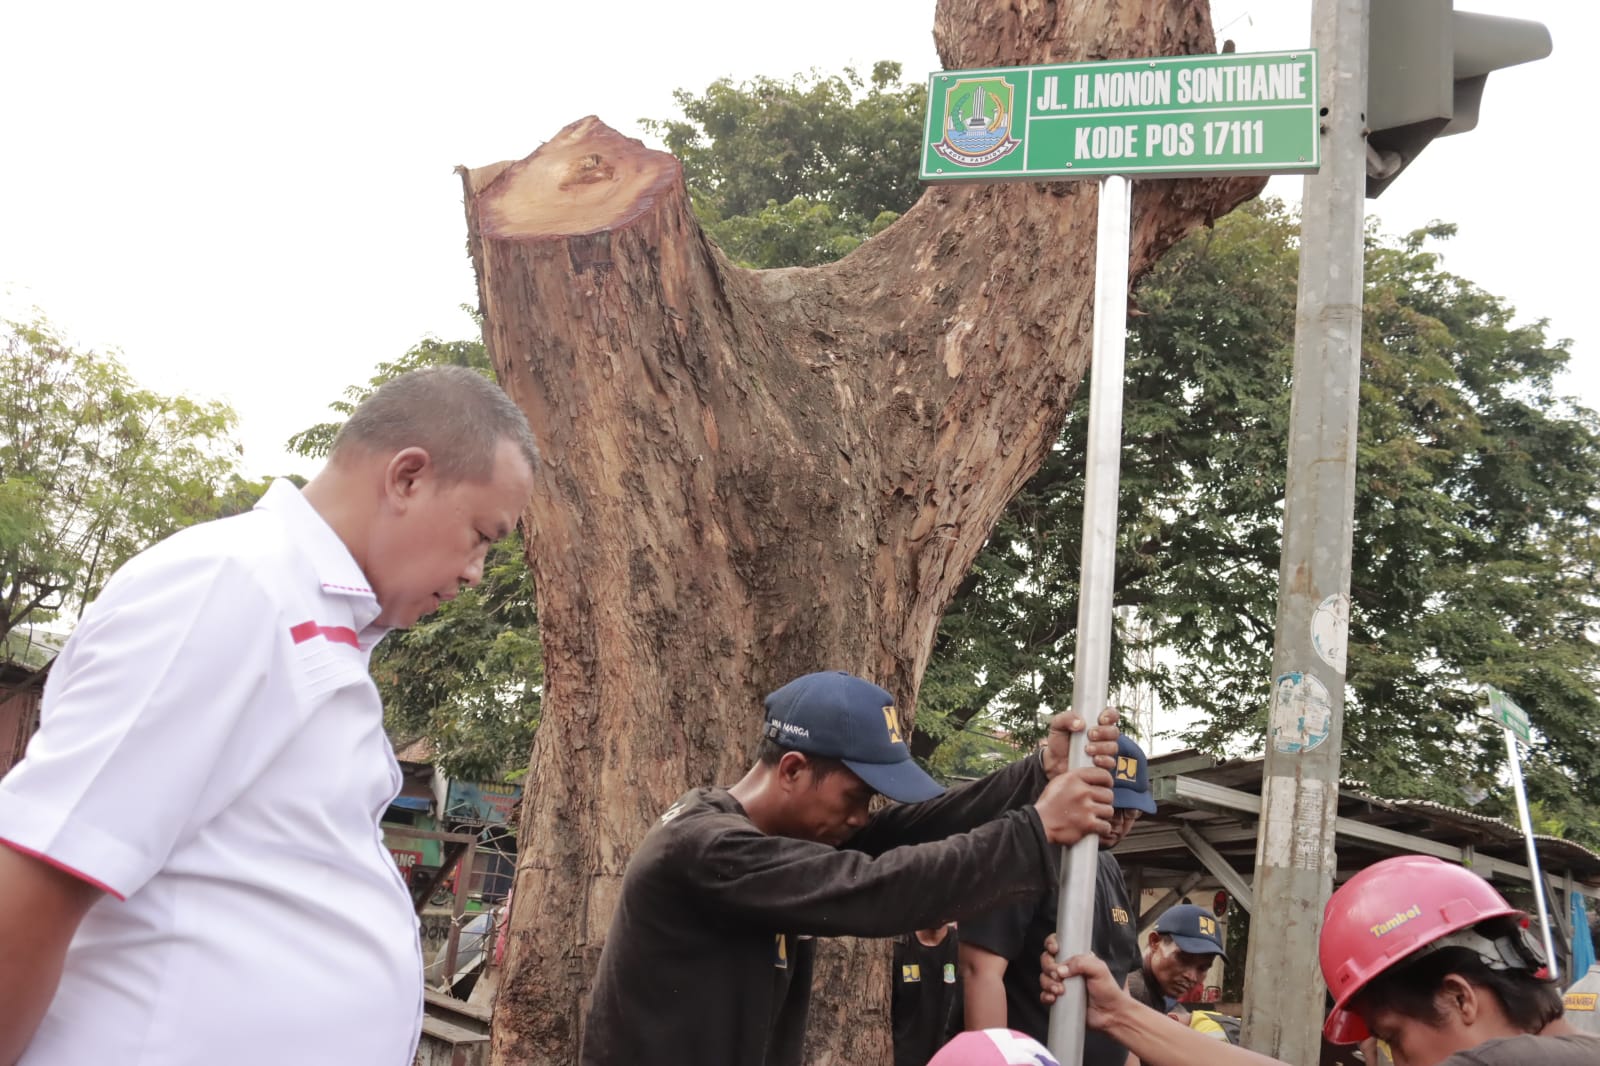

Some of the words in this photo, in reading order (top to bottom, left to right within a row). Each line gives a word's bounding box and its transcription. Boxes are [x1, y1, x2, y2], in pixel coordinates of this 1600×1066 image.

[1036, 76, 1068, 111] JL.
[1074, 69, 1171, 110] H.NONON
[1177, 62, 1307, 104] SONTHANIE
[1074, 124, 1139, 160] KODE
[1145, 122, 1195, 157] POS
[1203, 120, 1264, 156] 17111
[782, 722, 810, 738] MARGA
